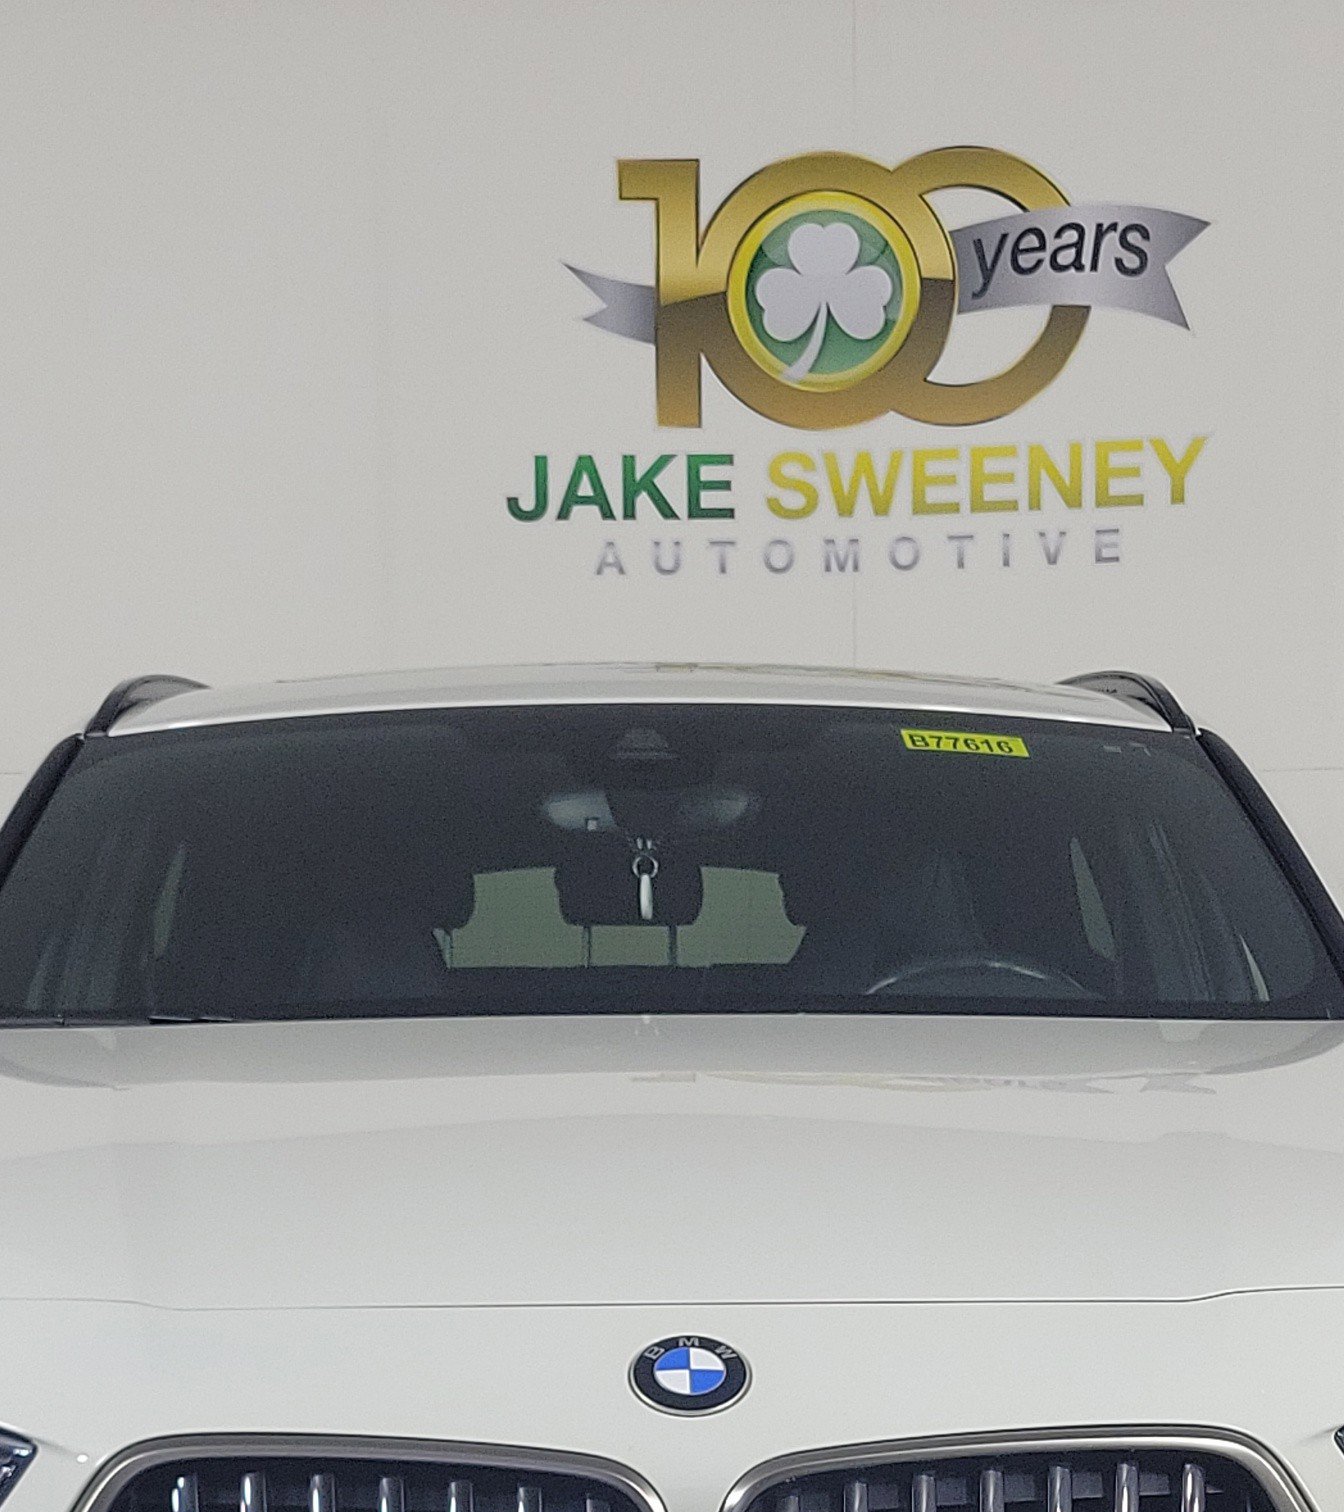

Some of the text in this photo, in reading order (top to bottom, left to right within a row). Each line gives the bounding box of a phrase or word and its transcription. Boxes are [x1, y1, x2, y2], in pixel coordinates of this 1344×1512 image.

[616, 146, 1152, 430] 100 years
[506, 435, 1209, 522] JAKE SWEENEY
[594, 528, 1122, 577] AUTOMOTIVE
[907, 733, 1014, 754] B77616
[644, 1337, 737, 1360] BMW
